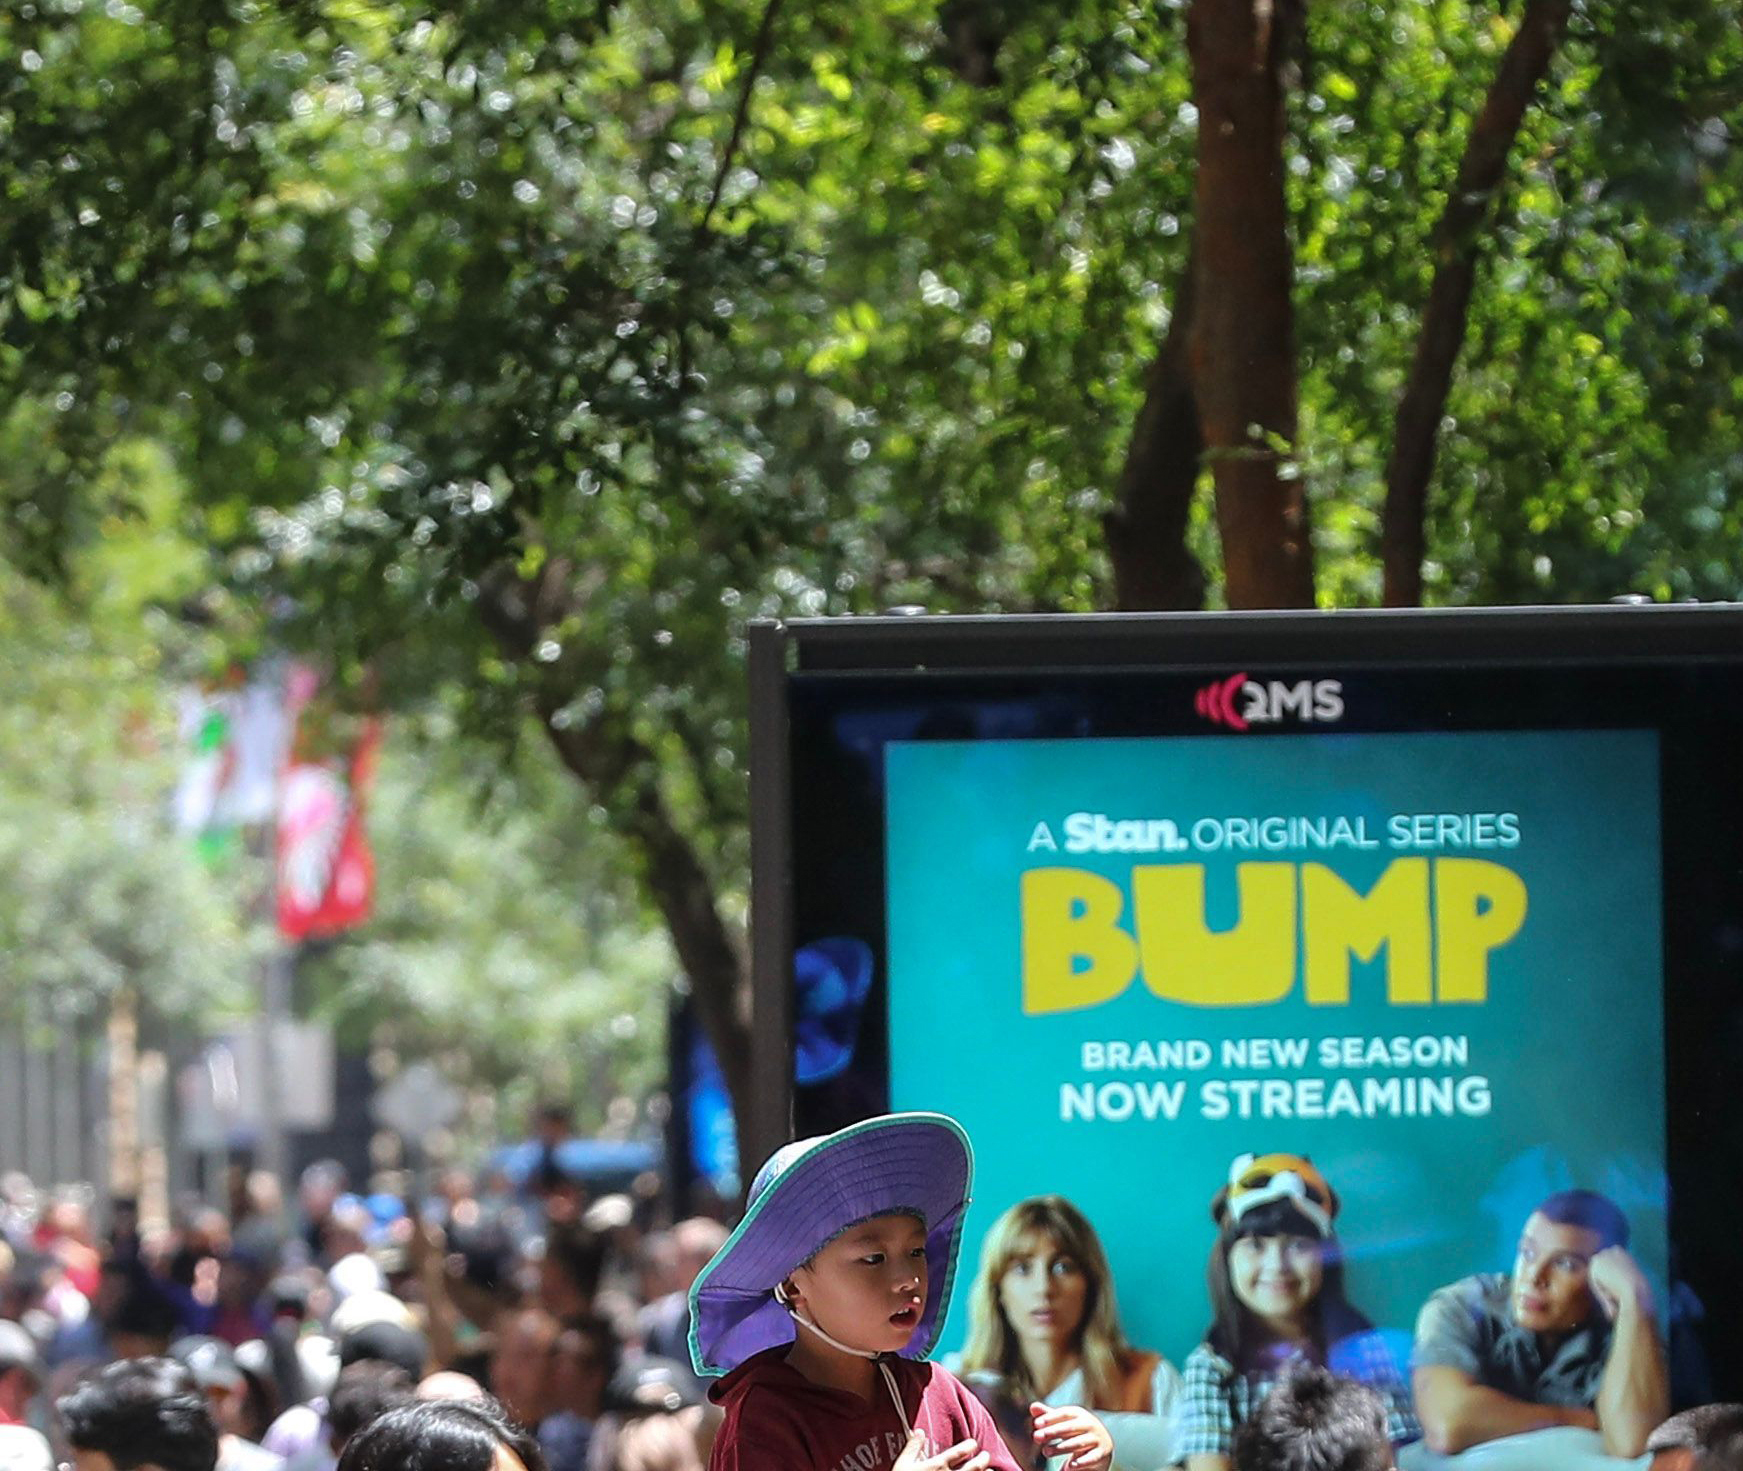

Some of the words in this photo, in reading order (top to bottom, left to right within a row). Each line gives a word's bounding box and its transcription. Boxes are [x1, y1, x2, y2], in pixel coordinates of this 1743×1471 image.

[1218, 673, 1345, 731] QMS
[1027, 821, 1056, 852] A
[1063, 812, 1188, 852] Stan.
[1192, 816, 1378, 849] ORIGINAL
[1387, 813, 1520, 848] SERIES
[1021, 856, 1528, 1017] BUMP
[1081, 1040, 1210, 1070] BRAND
[1222, 1038, 1309, 1068] NEW
[1318, 1035, 1467, 1067] SEASON
[1059, 1081, 1186, 1121] NOW
[1200, 1076, 1492, 1118] STREAMING
